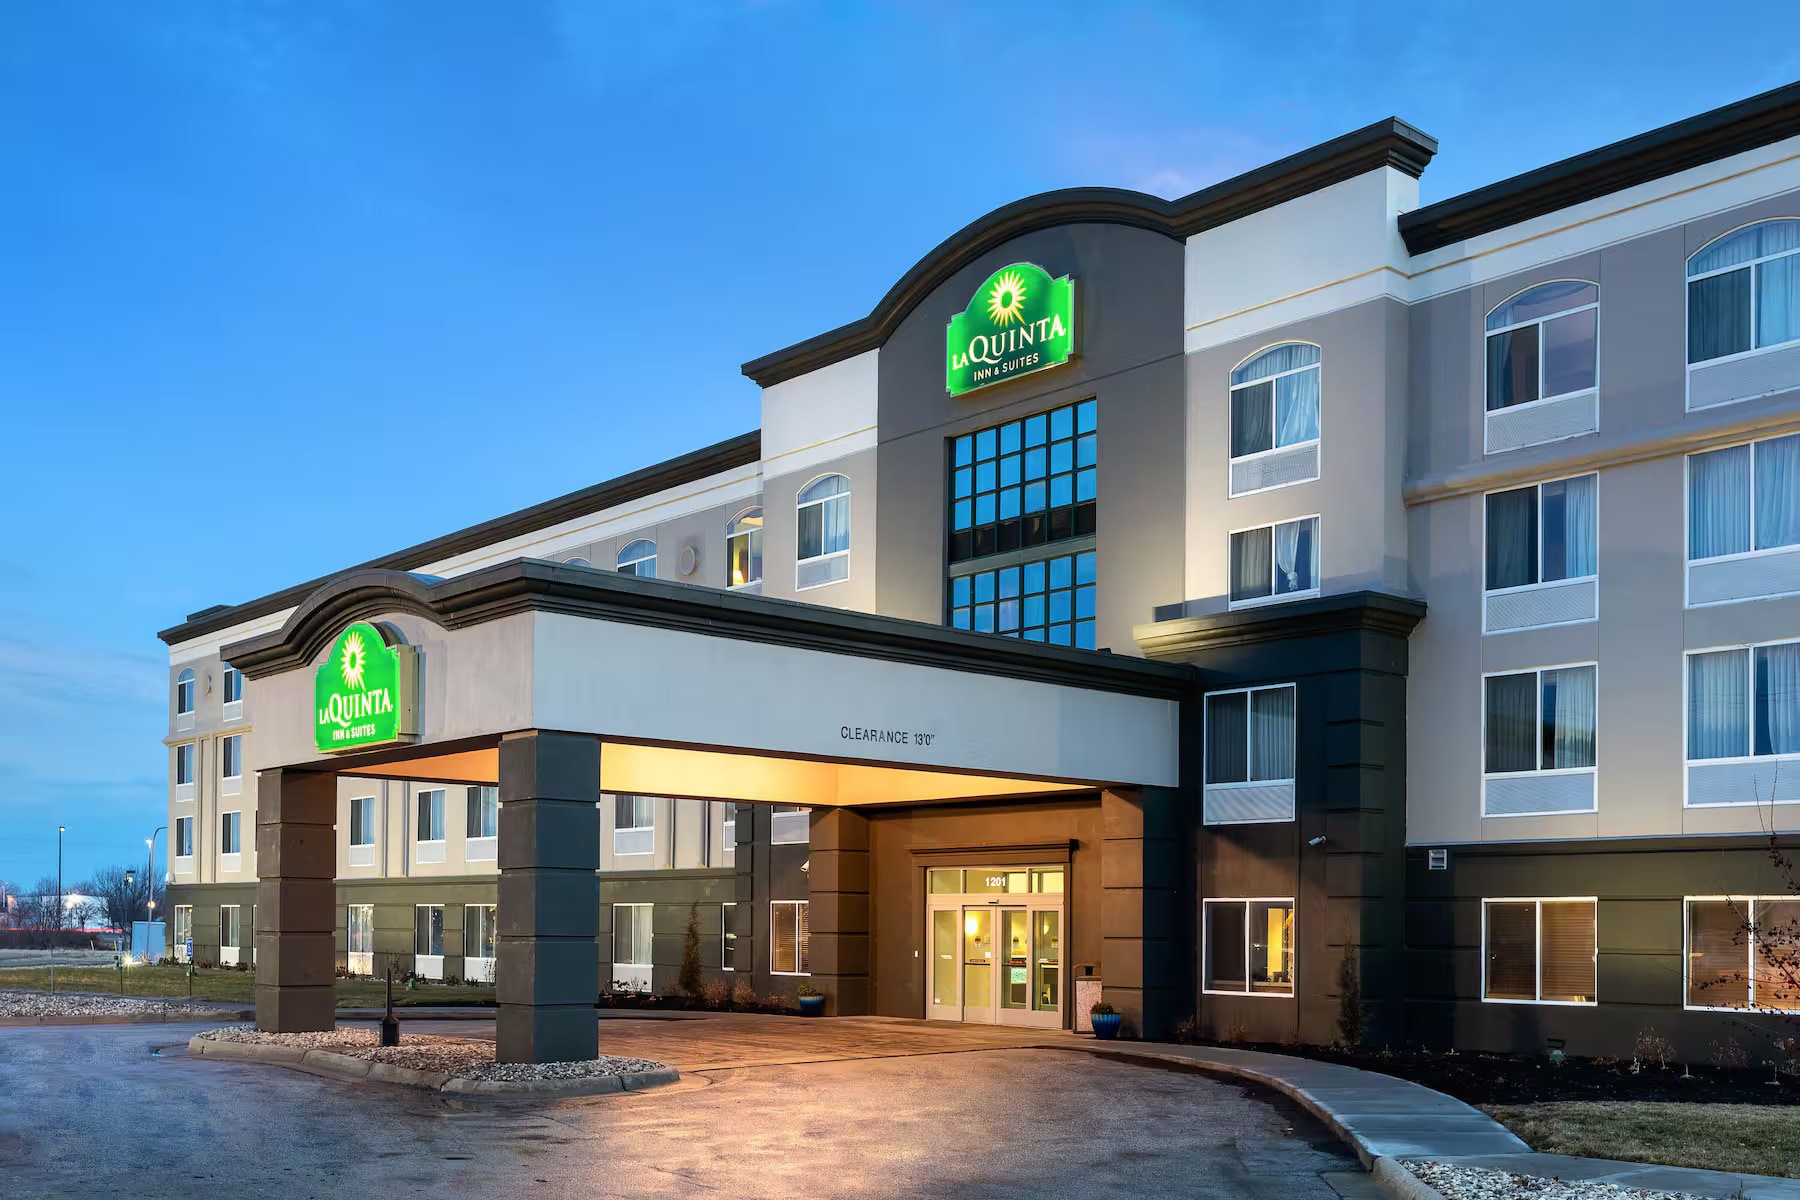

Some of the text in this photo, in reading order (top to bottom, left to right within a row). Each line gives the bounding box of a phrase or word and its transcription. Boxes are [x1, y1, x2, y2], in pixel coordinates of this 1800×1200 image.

[952, 313, 1066, 370] LA QUINTA
[973, 352, 1039, 382] INN & SUITES
[319, 687, 393, 728] LA QUINTA
[332, 723, 376, 741] INN & SUITES
[840, 725, 909, 744] CLEARANCE
[985, 876, 1006, 887] 1201
